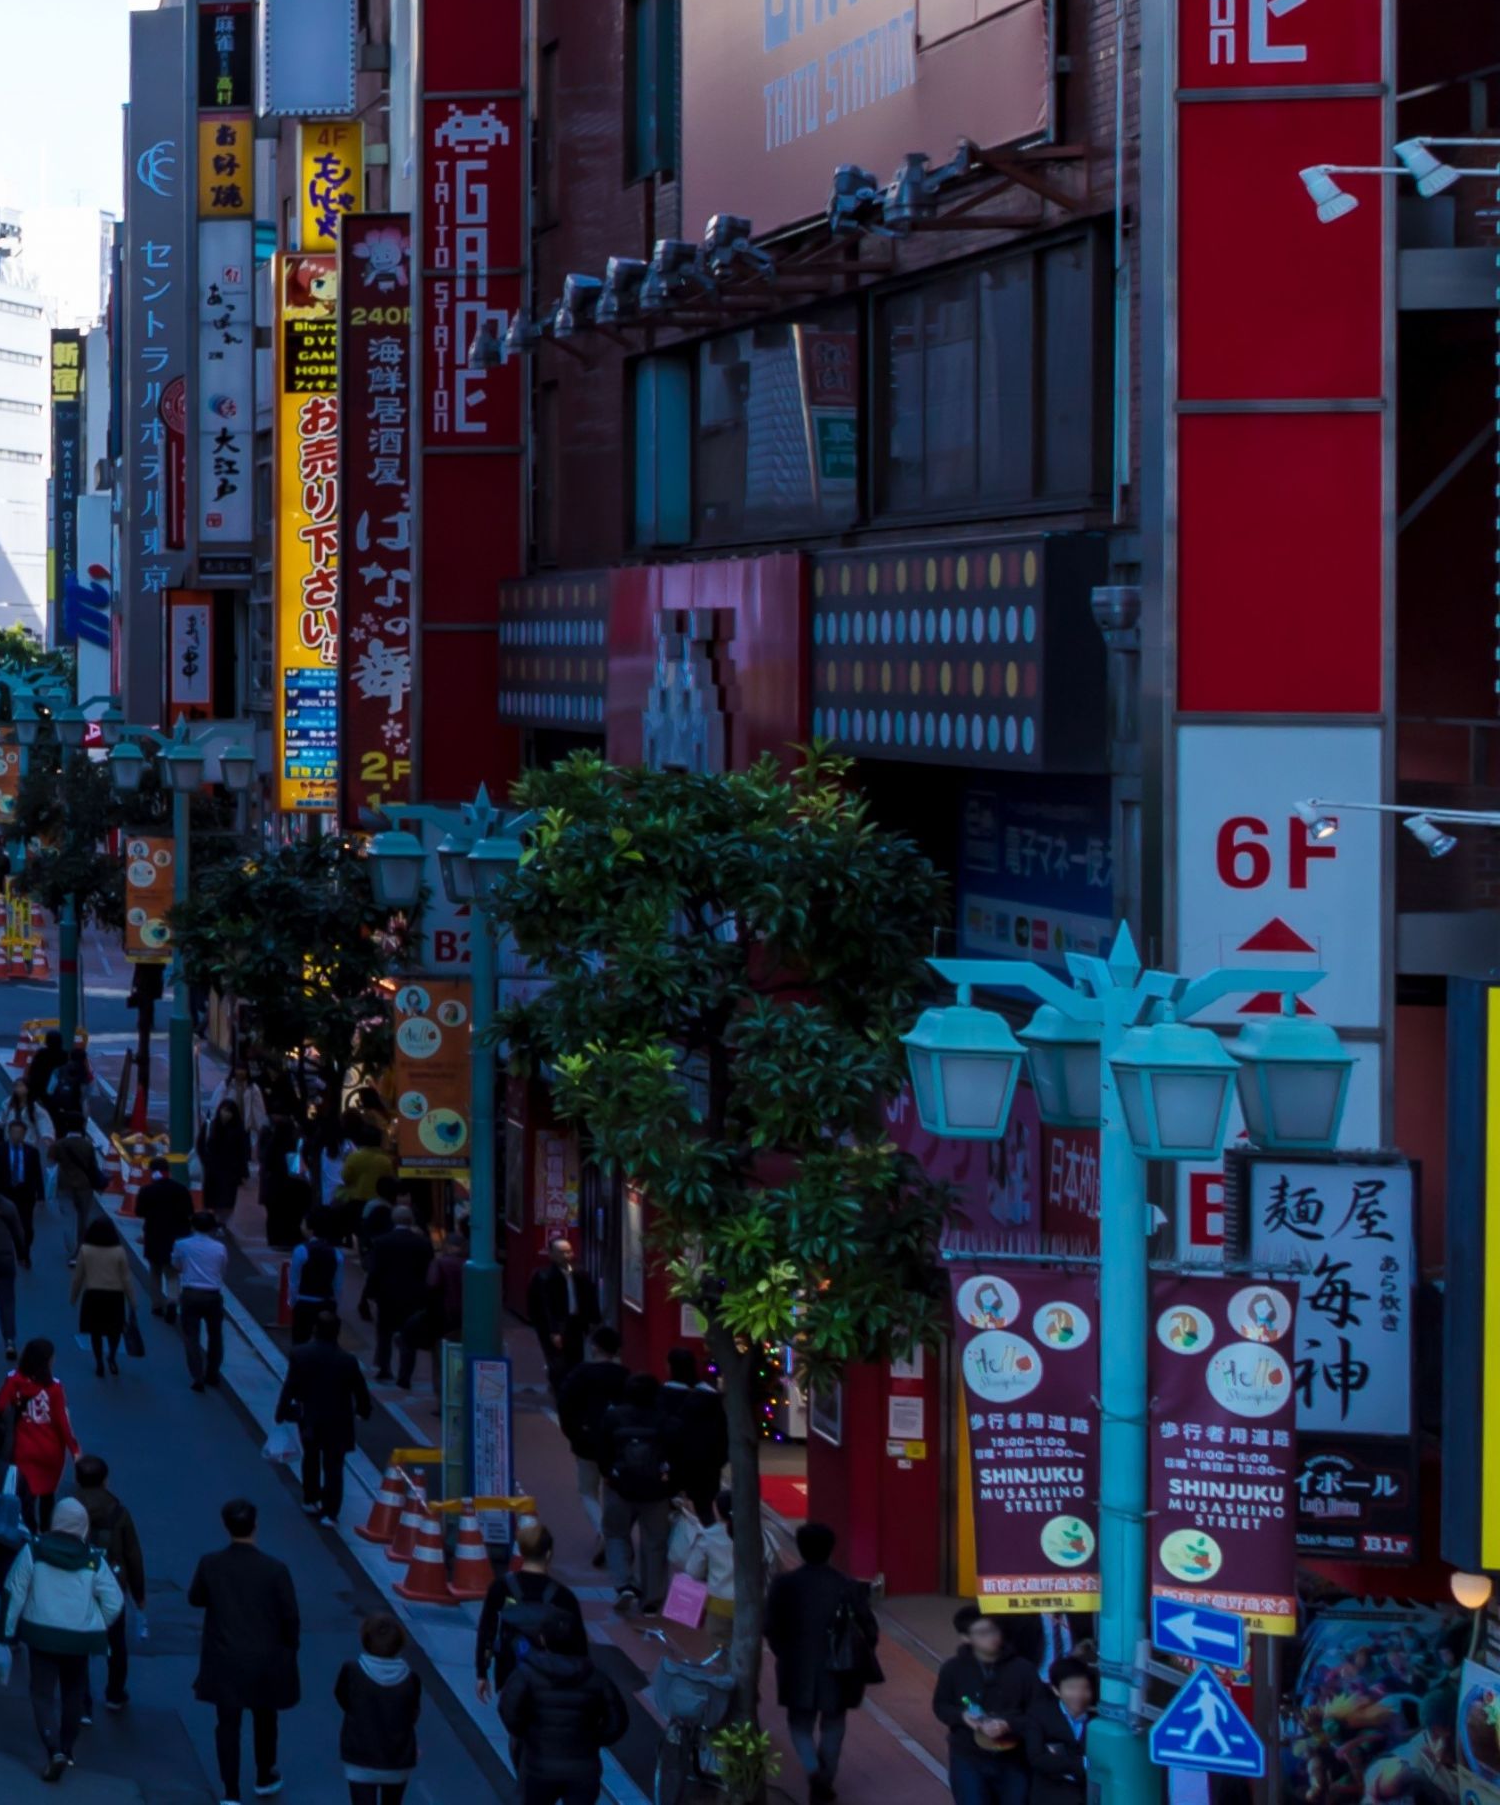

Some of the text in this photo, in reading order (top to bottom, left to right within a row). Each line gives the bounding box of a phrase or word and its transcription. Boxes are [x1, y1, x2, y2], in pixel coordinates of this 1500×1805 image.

[765, 9, 915, 151] TAITO STATION
[317, 127, 347, 146] 4F
[213, 125, 243, 208] お好焼
[434, 160, 449, 432] TAITO STATION
[455, 159, 508, 433] GAME
[52, 341, 80, 398] 新宿
[140, 239, 173, 594] セントラルホテル東京
[366, 335, 406, 487] 海鮮居酒屋
[62, 439, 73, 501] WASHIN
[212, 426, 241, 501] 大江戸
[360, 750, 412, 781] 2F
[1215, 816, 1340, 890] 6F
[1263, 1174, 1395, 1241] 麺屋
[1379, 1255, 1401, 1333] あら炊き
[970, 1412, 1090, 1435] 歩行者用道路
[1159, 1421, 1291, 1449] 歩行者用道路
[980, 1465, 1084, 1486] SHINJUKU
[980, 1486, 1085, 1500] MUSASHINO
[1169, 1478, 1285, 1504] SHINJUKU
[1004, 1499, 1063, 1513] STREET
[1168, 1499, 1285, 1519] MUSASHINO
[1195, 1514, 1262, 1531] STREET
